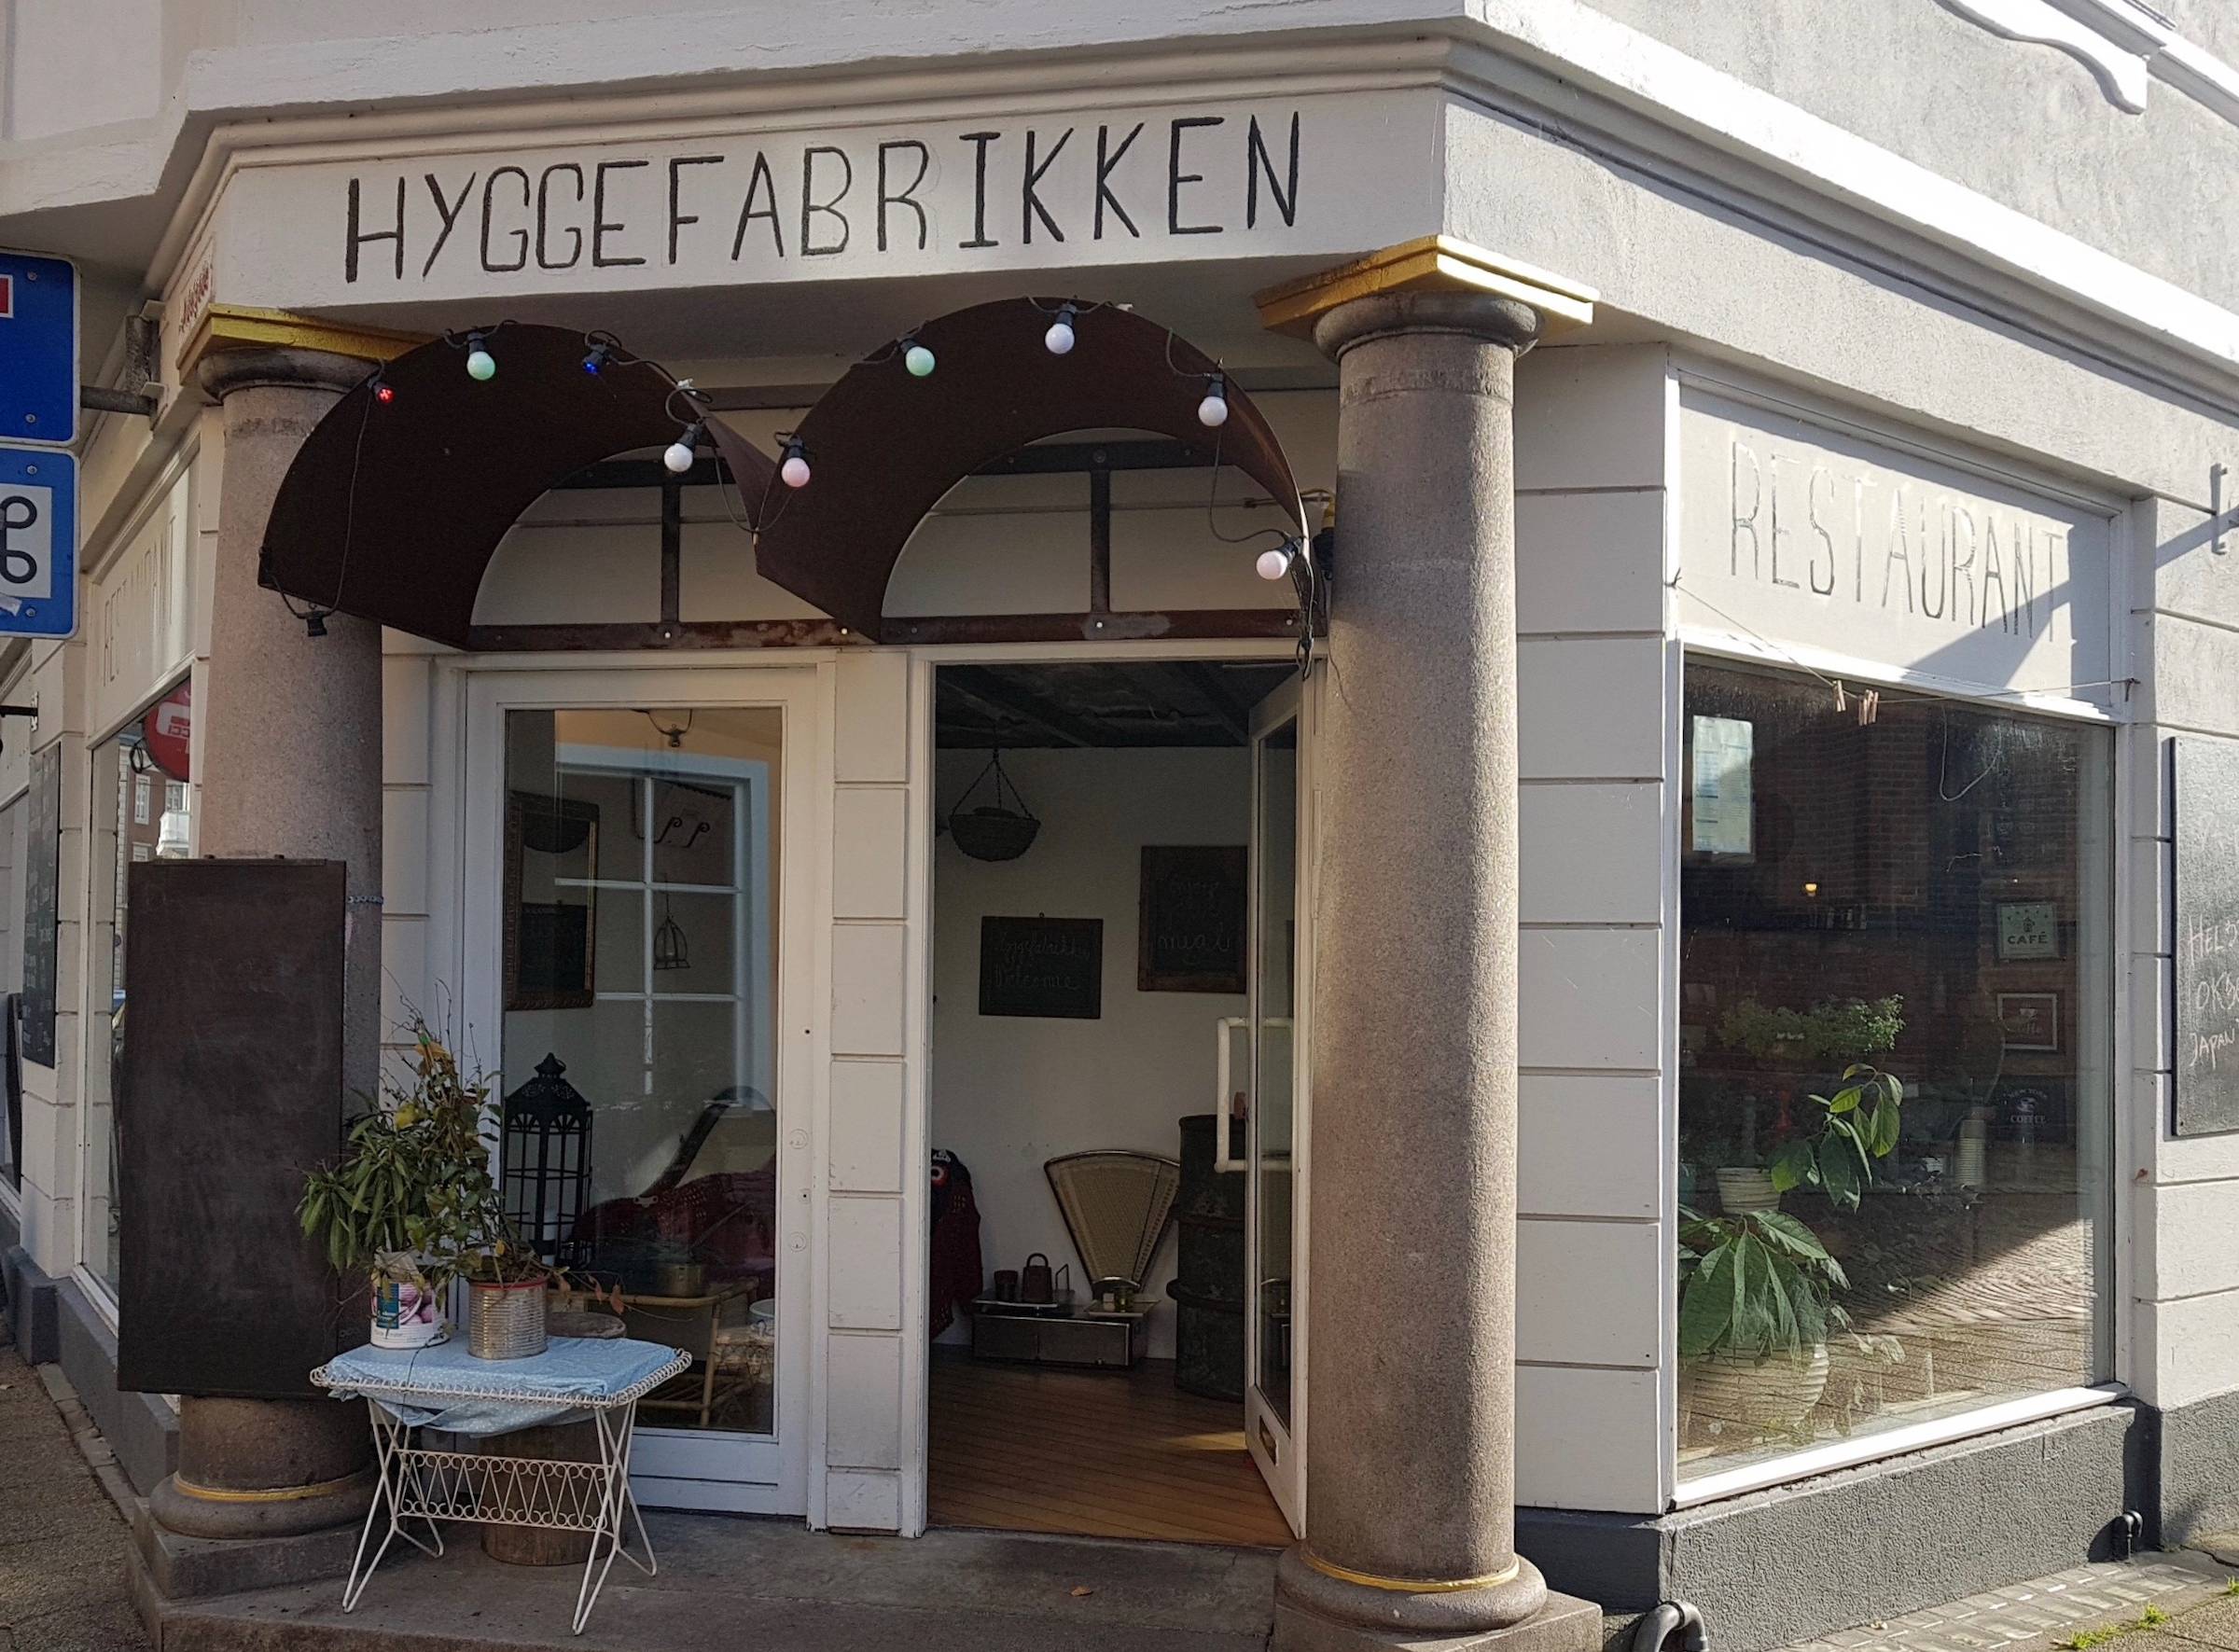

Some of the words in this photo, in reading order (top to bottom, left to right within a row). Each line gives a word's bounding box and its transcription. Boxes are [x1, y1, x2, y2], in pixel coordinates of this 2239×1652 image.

[346, 111, 1300, 284] HYGGEFABRIKKEN
[1731, 441, 2064, 642] RESTAURANT
[2007, 931, 2049, 945] CAFÉ
[2190, 1028, 2235, 1071] JAPAN
